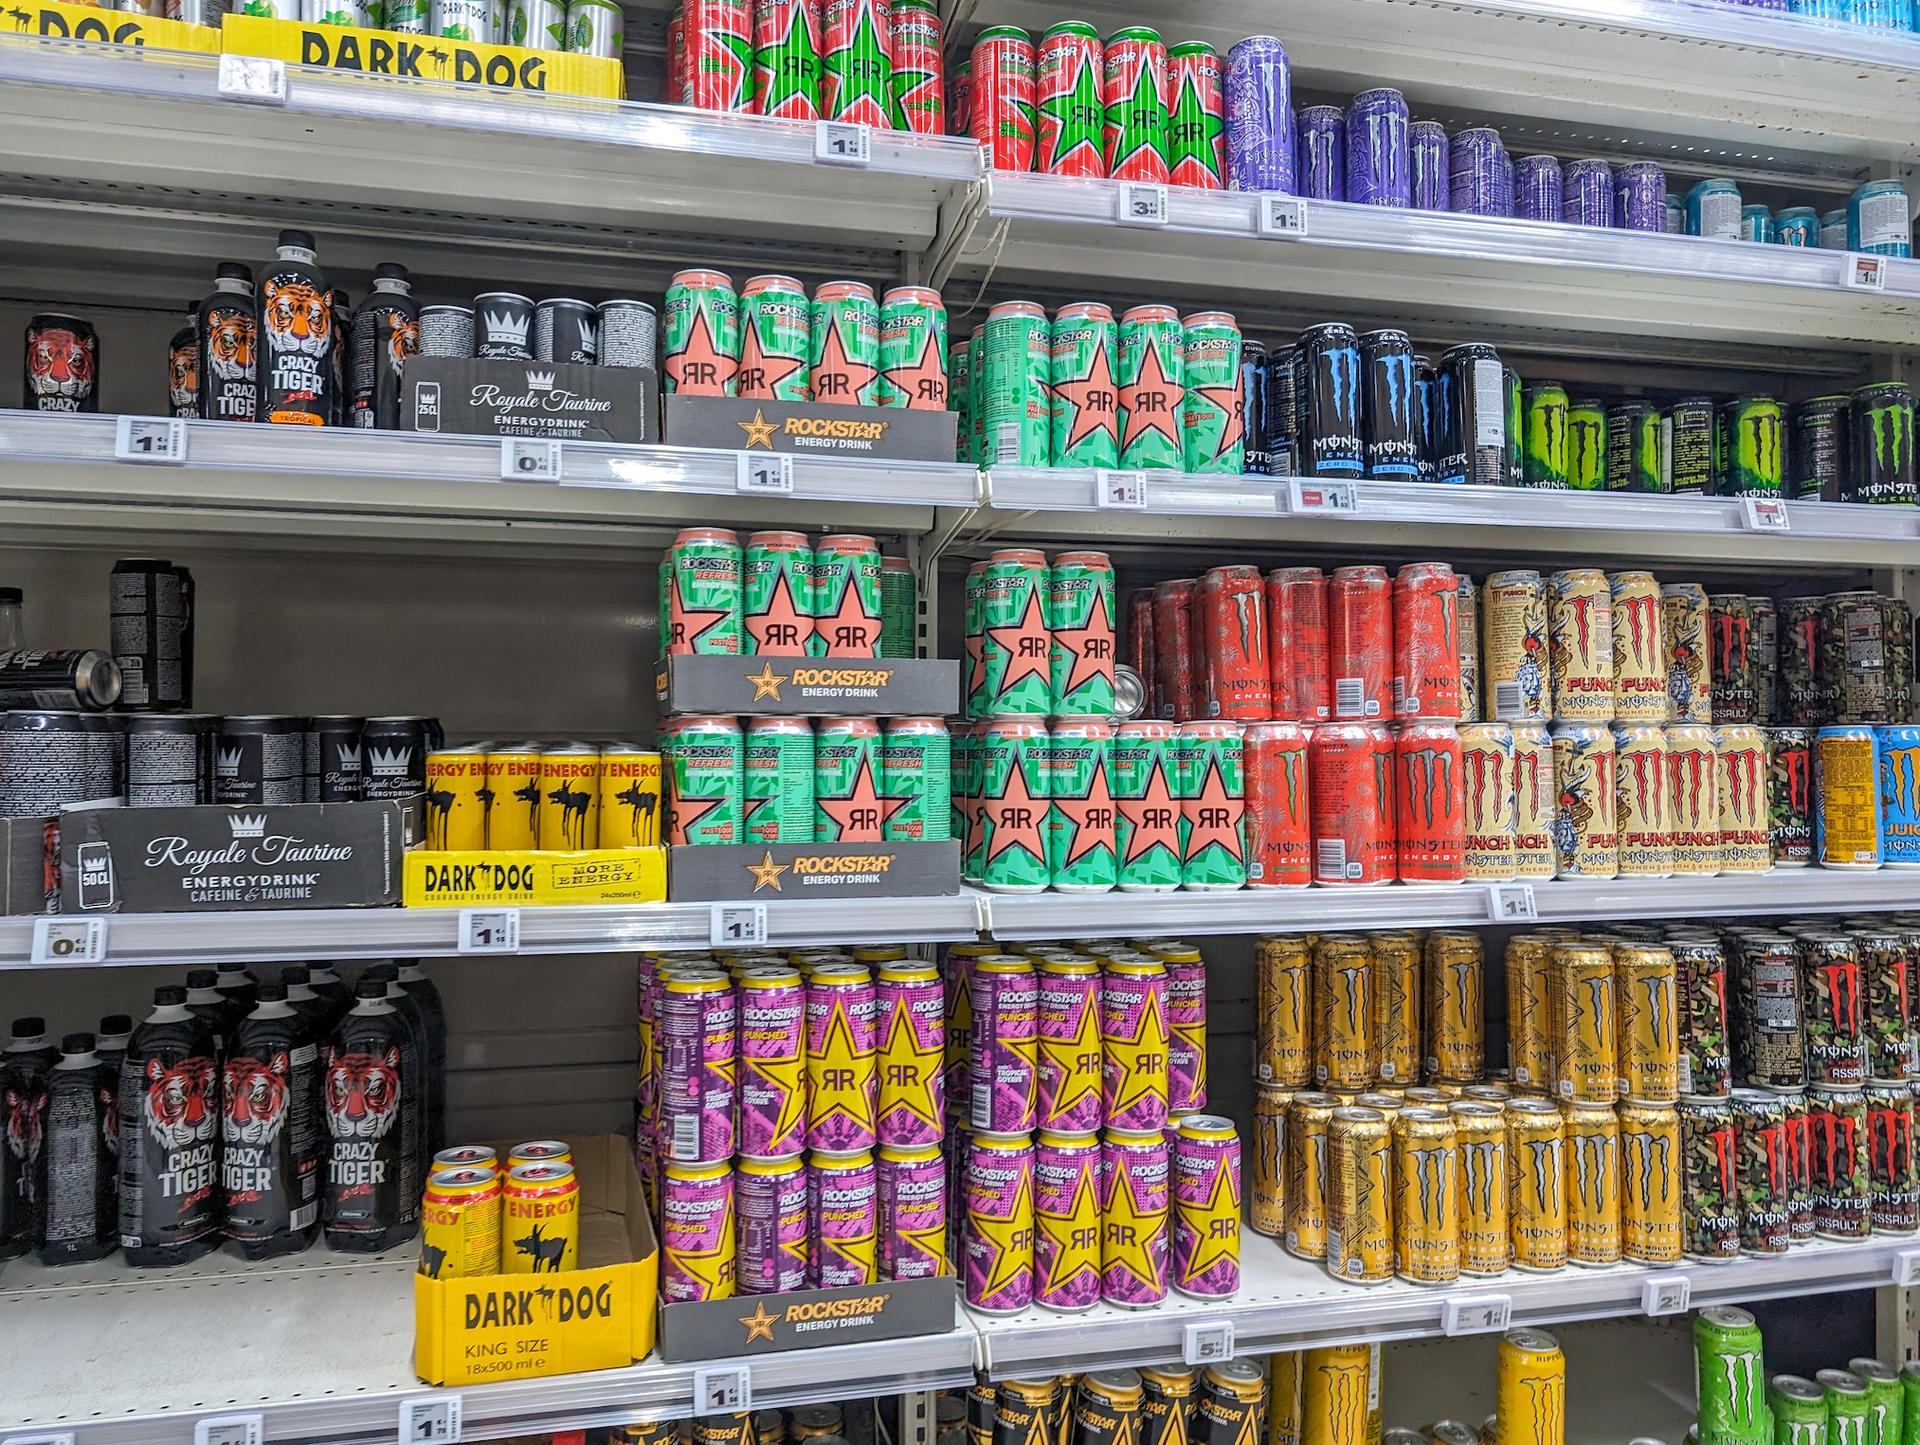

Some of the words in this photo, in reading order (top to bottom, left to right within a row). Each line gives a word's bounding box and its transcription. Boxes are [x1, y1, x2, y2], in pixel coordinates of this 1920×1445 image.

[40, 9, 145, 57] DOG
[302, 31, 424, 84] DARK
[454, 48, 546, 98] DOG
[833, 140, 845, 153] 1
[1134, 202, 1149, 215] 3
[1275, 214, 1287, 227] 1
[1862, 271, 1869, 283] 1
[1186, 333, 1239, 352] ROCKSTAR
[278, 355, 318, 375] CRAZY
[272, 371, 323, 395] TIGER
[39, 397, 80, 412] CRAZY
[469, 384, 540, 415] Royale
[541, 389, 612, 413] Taurine
[418, 402, 438, 417] 25CL
[277, 416, 314, 425] TROPICAL
[494, 415, 584, 430] ENERGYDRINK
[500, 426, 536, 438] CAFEINE
[547, 427, 583, 438] TAURINE
[785, 417, 883, 448] ROCKSTAR
[137, 437, 152, 451] 1
[795, 436, 838, 450] ENERGY
[839, 438, 873, 452] DRINK
[519, 457, 537, 471] 0
[755, 470, 767, 483] 1
[1113, 488, 1124, 501] 1
[1330, 492, 1338, 508] 1
[1766, 513, 1774, 525] 1
[680, 557, 738, 572] ROCKSTAR
[695, 570, 737, 581] REFRESH
[792, 666, 888, 689] ROCKSTAR
[802, 684, 843, 698] ENERGY
[844, 684, 878, 698] DRINK
[544, 763, 597, 778] ENERGY
[688, 758, 733, 769] REFRESH
[363, 776, 392, 797] Royale
[392, 774, 423, 792] Taurine
[145, 835, 249, 881] Royale
[251, 834, 353, 871] Taurine
[793, 855, 888, 874] ROCKSTAR
[1405, 854, 1459, 865] ENERGY
[572, 864, 625, 876] MORE
[83, 869, 111, 887] 50CL
[181, 873, 316, 889] ENERGYDRINK
[425, 864, 475, 892] DARK
[495, 864, 534, 891] DOG
[559, 873, 635, 886] ENERGY
[803, 873, 845, 886] ENERGY
[846, 873, 881, 885] DRINK
[190, 887, 243, 903] CAFEINE
[260, 887, 313, 901] TAURINE
[1505, 902, 1516, 915] 1
[477, 928, 491, 945] 1
[728, 923, 741, 938] 1
[52, 938, 74, 955] 0
[744, 1006, 801, 1021] ROCKSTAR
[744, 1031, 788, 1042] PUNCHED
[168, 1142, 214, 1172] CRAZY
[224, 1147, 264, 1168] CRAZY
[333, 1140, 380, 1161] CRAZY
[158, 1161, 218, 1198] TIGER
[221, 1166, 273, 1192] TIGER
[328, 1162, 388, 1185] TIGER
[823, 1184, 877, 1202] ROCKSTAR
[509, 1195, 578, 1220] ENERGY
[665, 1198, 724, 1214] ROCKSTAR
[898, 1201, 940, 1215] PUNCHED
[822, 1209, 866, 1223] PUNCHED
[667, 1222, 708, 1234] PUNCHED
[465, 1290, 535, 1331] DARK
[558, 1280, 612, 1323] DOG
[786, 1297, 884, 1322] ROCKSTAR
[1661, 1297, 1674, 1309] 2
[795, 1319, 838, 1333] ENERGY
[839, 1315, 874, 1330] DRINK
[1483, 1311, 1493, 1326] 1
[465, 1342, 508, 1359] KING
[516, 1339, 550, 1353] SIZE
[1200, 1344, 1215, 1357] 5
[466, 1361, 513, 1376] 18x500
[516, 1359, 534, 1371] ml
[712, 1390, 725, 1405] 1
[417, 1420, 433, 1438] 1
